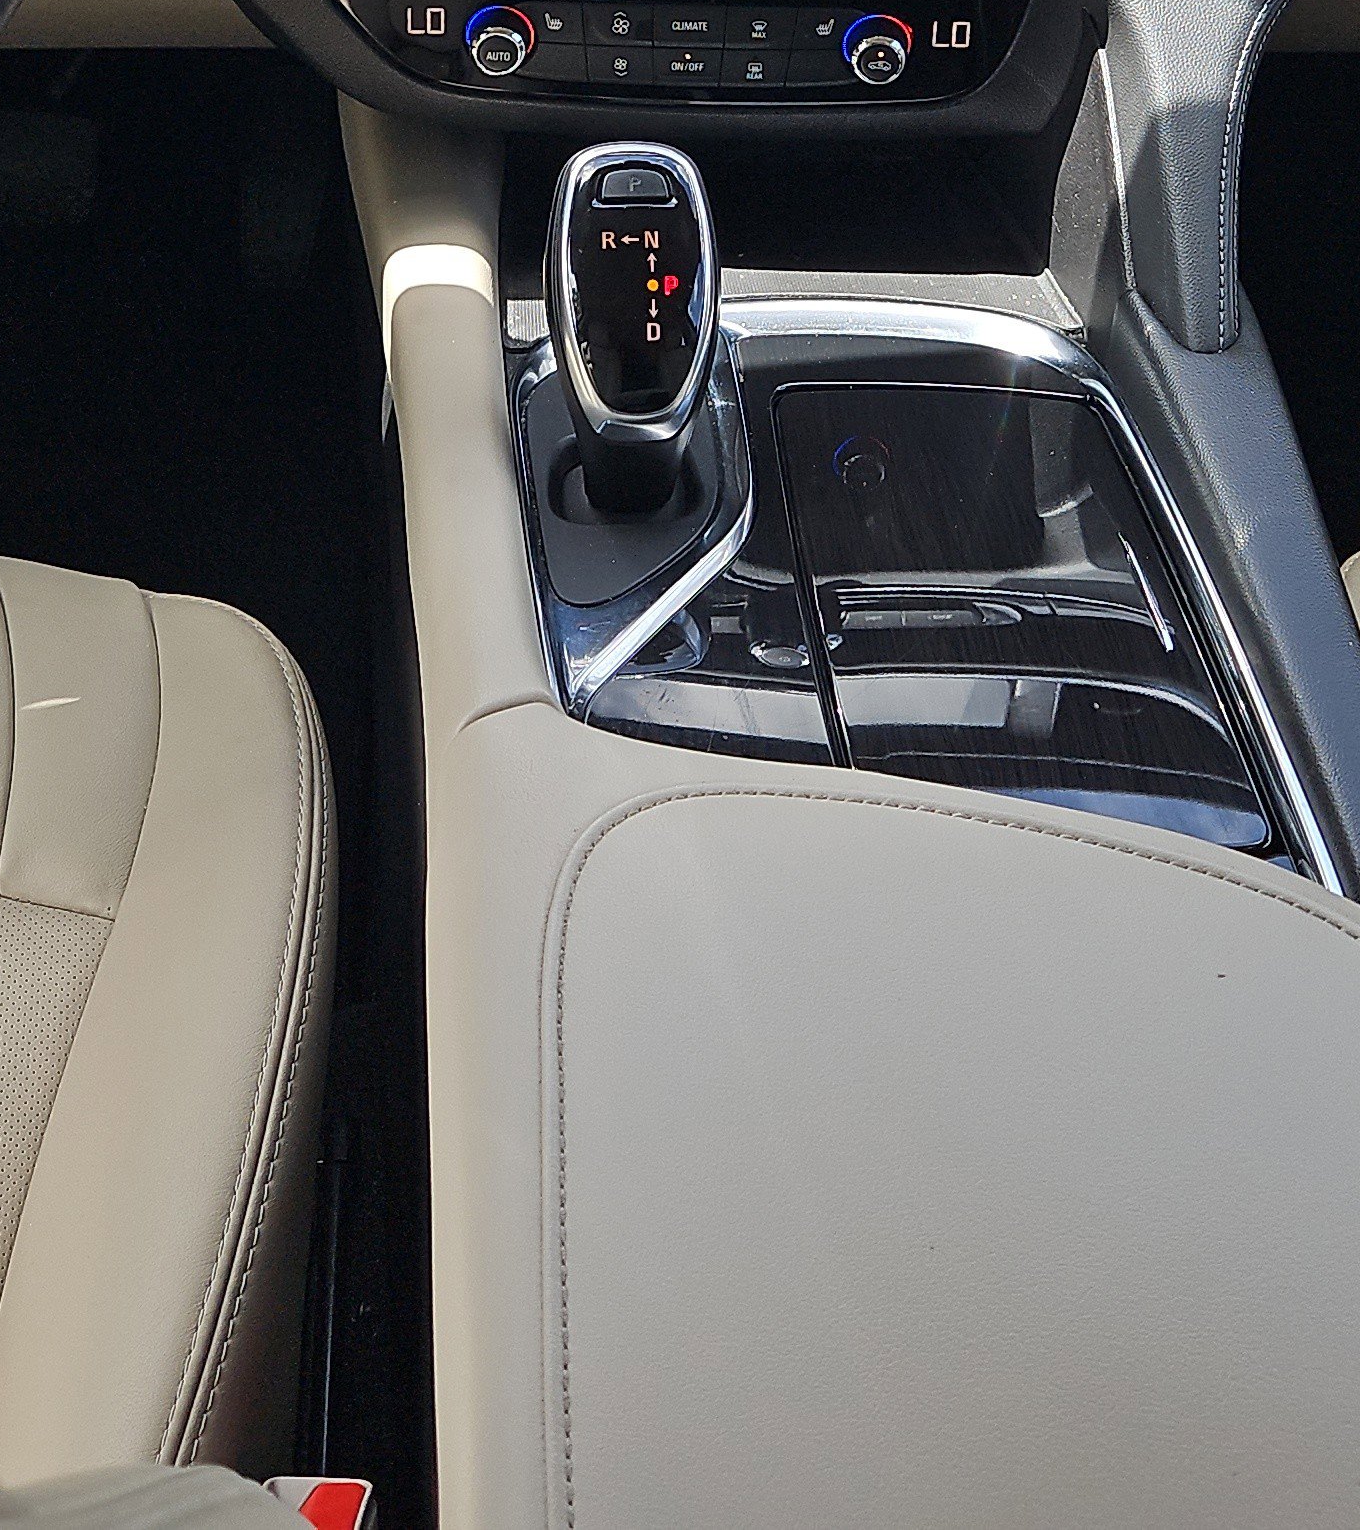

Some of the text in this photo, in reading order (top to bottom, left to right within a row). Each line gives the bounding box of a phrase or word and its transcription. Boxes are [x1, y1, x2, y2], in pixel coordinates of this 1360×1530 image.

[406, 7, 446, 35] LO
[671, 21, 708, 31] CLIMATE
[751, 31, 767, 39] MAX
[932, 20, 971, 48] LO
[485, 51, 511, 62] AUTO
[671, 62, 704, 72] ON/OFF
[628, 175, 642, 192] P
[601, 230, 660, 249] R N
[664, 275, 679, 296] P
[647, 322, 661, 342] D
